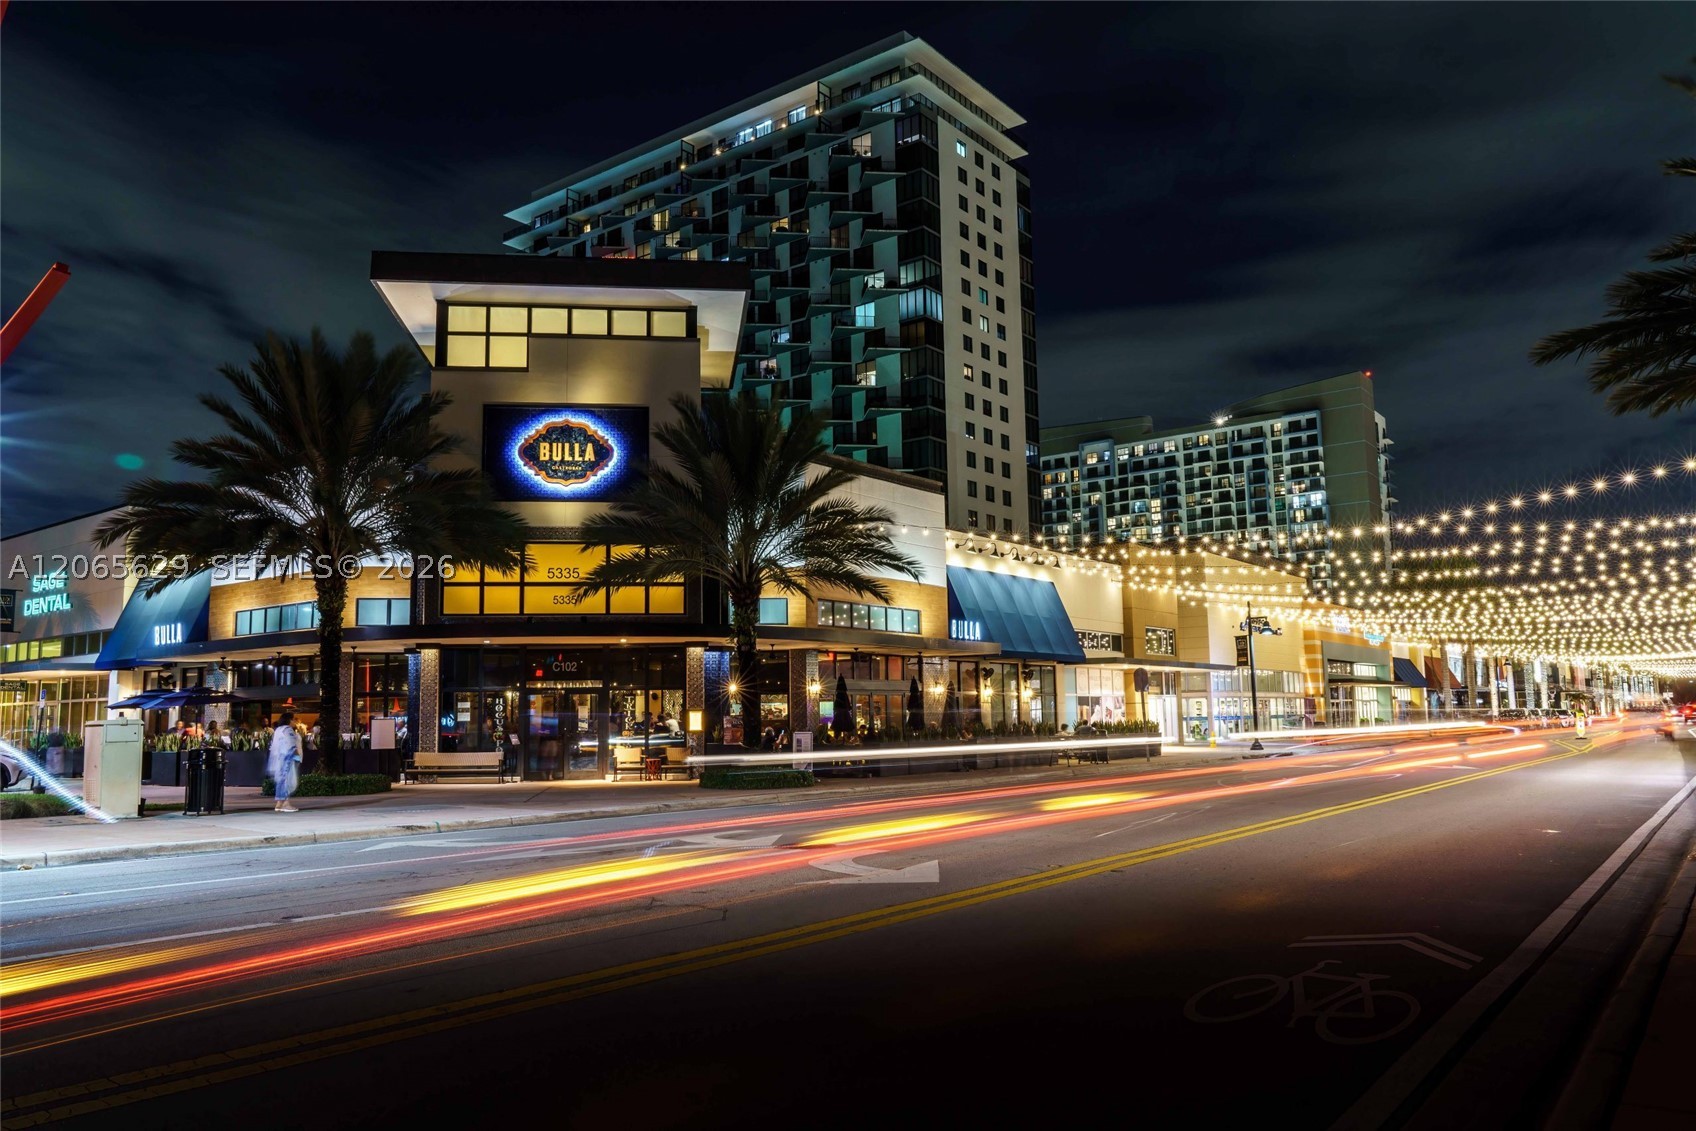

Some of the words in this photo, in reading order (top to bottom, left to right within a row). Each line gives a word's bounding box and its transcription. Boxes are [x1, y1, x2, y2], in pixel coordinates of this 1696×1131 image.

[539, 442, 596, 461] BULLA
[32, 570, 66, 593] SAGE
[547, 567, 580, 579] 5335
[23, 593, 72, 616] DENTAL
[552, 595, 577, 605] 5335
[154, 623, 182, 645] BULLA
[951, 619, 981, 641] BULLA
[552, 661, 577, 672] C102
